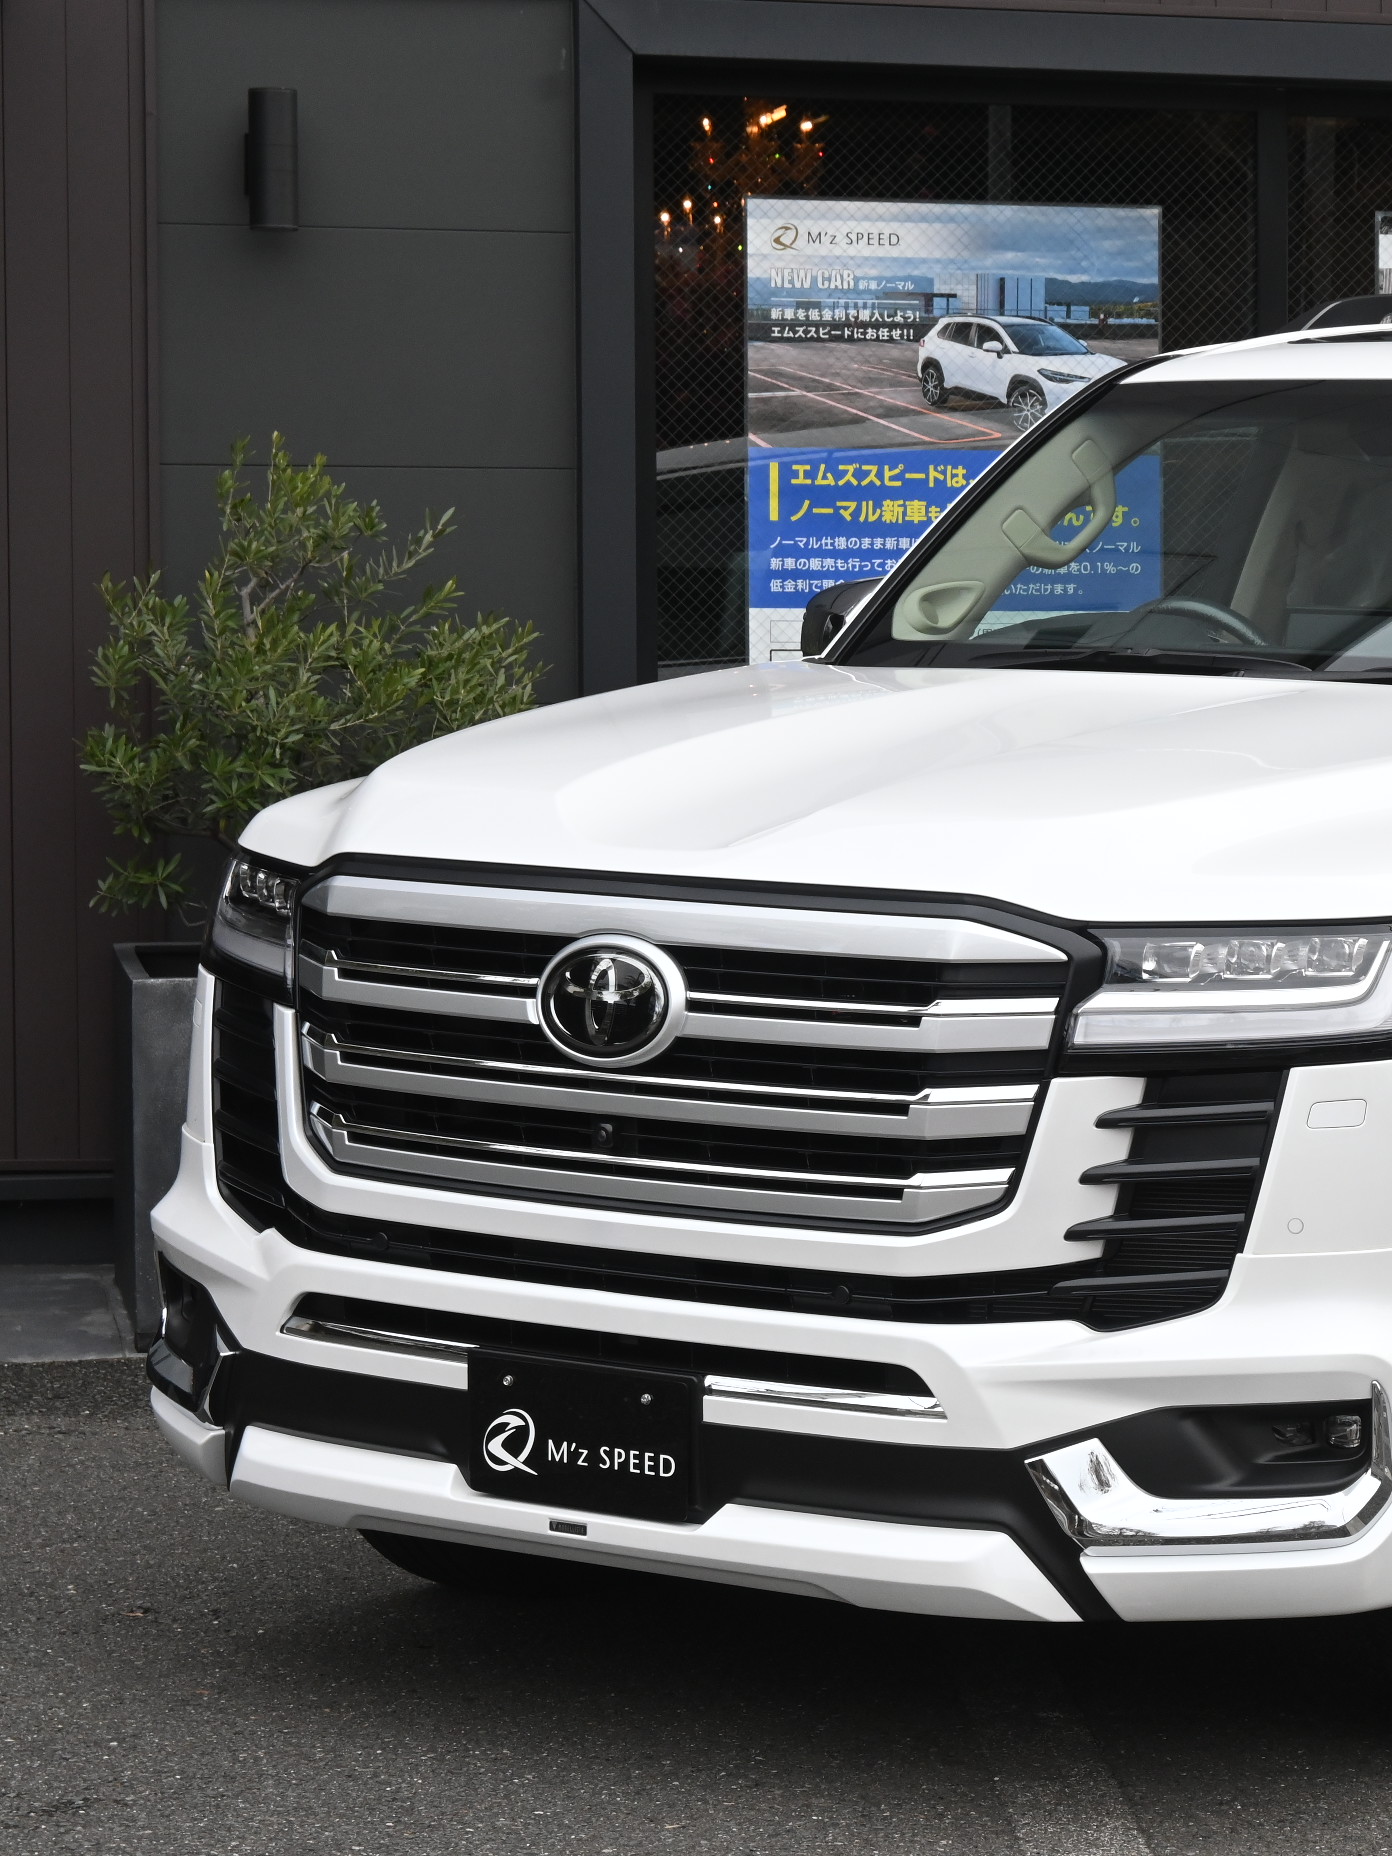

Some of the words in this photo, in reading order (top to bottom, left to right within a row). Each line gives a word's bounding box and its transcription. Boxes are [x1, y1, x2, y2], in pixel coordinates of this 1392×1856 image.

[807, 231, 837, 245] M'z
[845, 231, 900, 247] SPEED
[770, 267, 812, 289] NEW
[817, 268, 855, 290] CAR
[858, 279, 915, 291] 新車ノーマル
[791, 499, 951, 523] ノーマル新車も
[770, 557, 901, 571] 新車の販売も行ってお
[547, 1439, 588, 1466] M'z
[599, 1447, 676, 1477] SPEED
